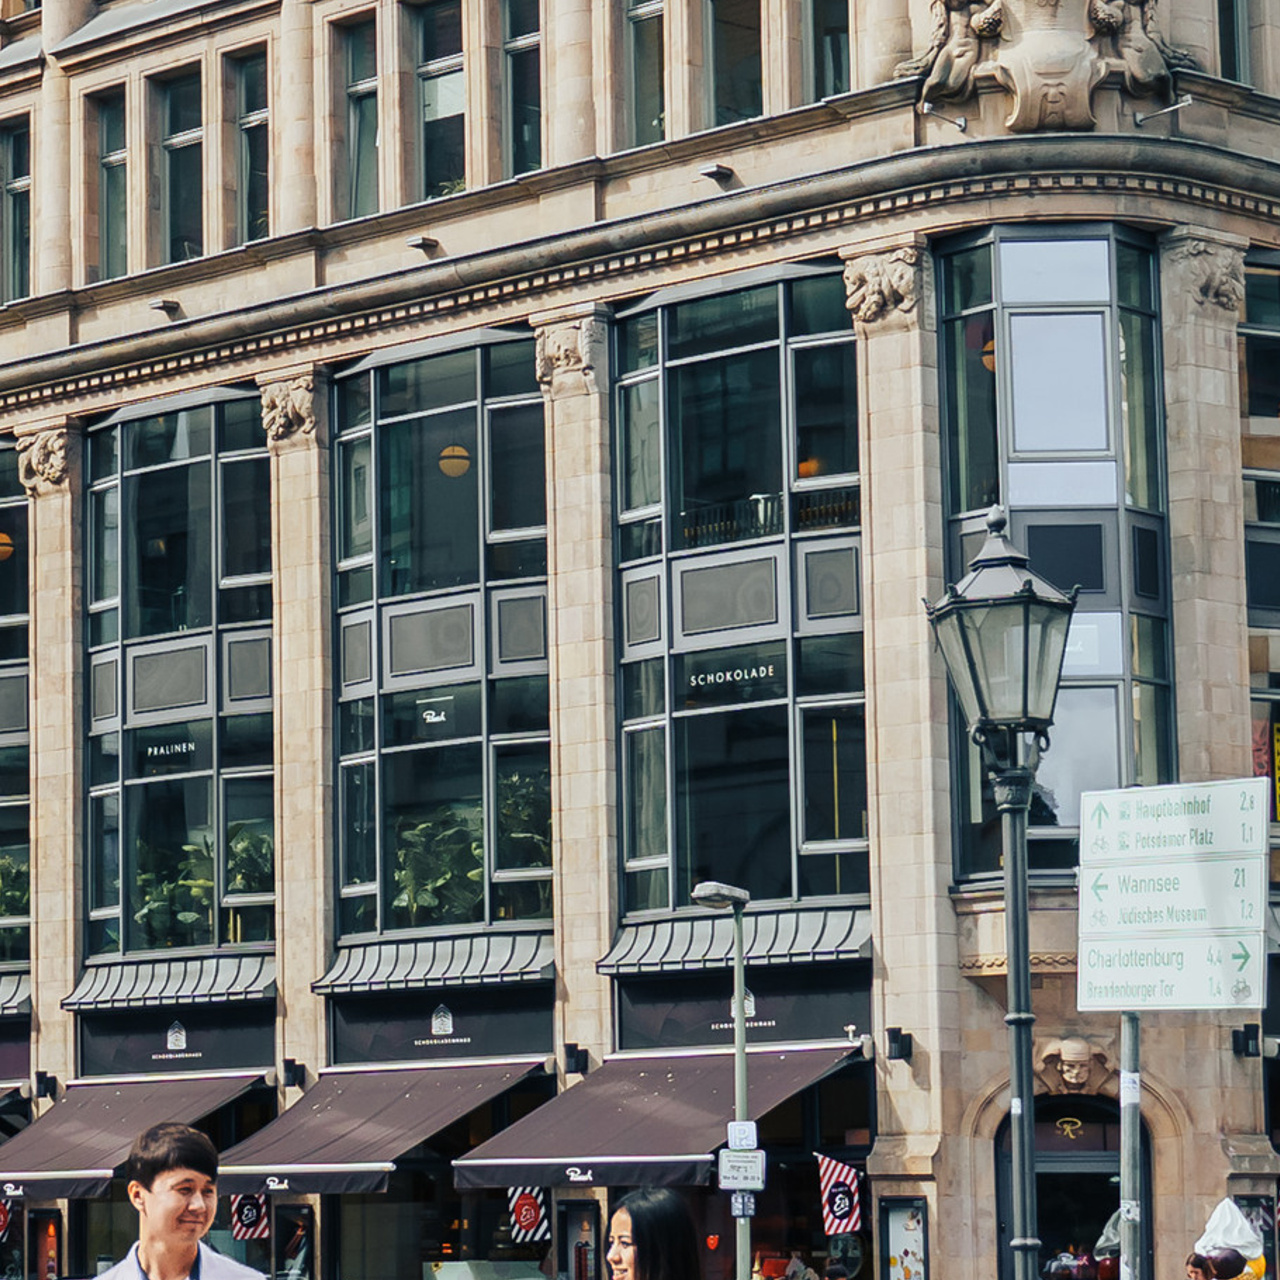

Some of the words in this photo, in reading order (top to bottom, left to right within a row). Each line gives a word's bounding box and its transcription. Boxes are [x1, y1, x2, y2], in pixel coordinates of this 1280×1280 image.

[690, 664, 774, 687] SCHOKOLADE
[147, 742, 195, 757] PRALINEN
[1135, 794, 1212, 821] Hauptbahnhof
[1135, 831, 1187, 850] Potsdamer
[1189, 827, 1214, 846] Platz
[1117, 874, 1180, 894] Wannsee
[1233, 868, 1246, 888] 21
[1166, 905, 1207, 923] Museum
[1087, 947, 1184, 971] Charlottenburg
[1086, 980, 1157, 1002] Brandenburger
[1159, 979, 1175, 998] Tor
